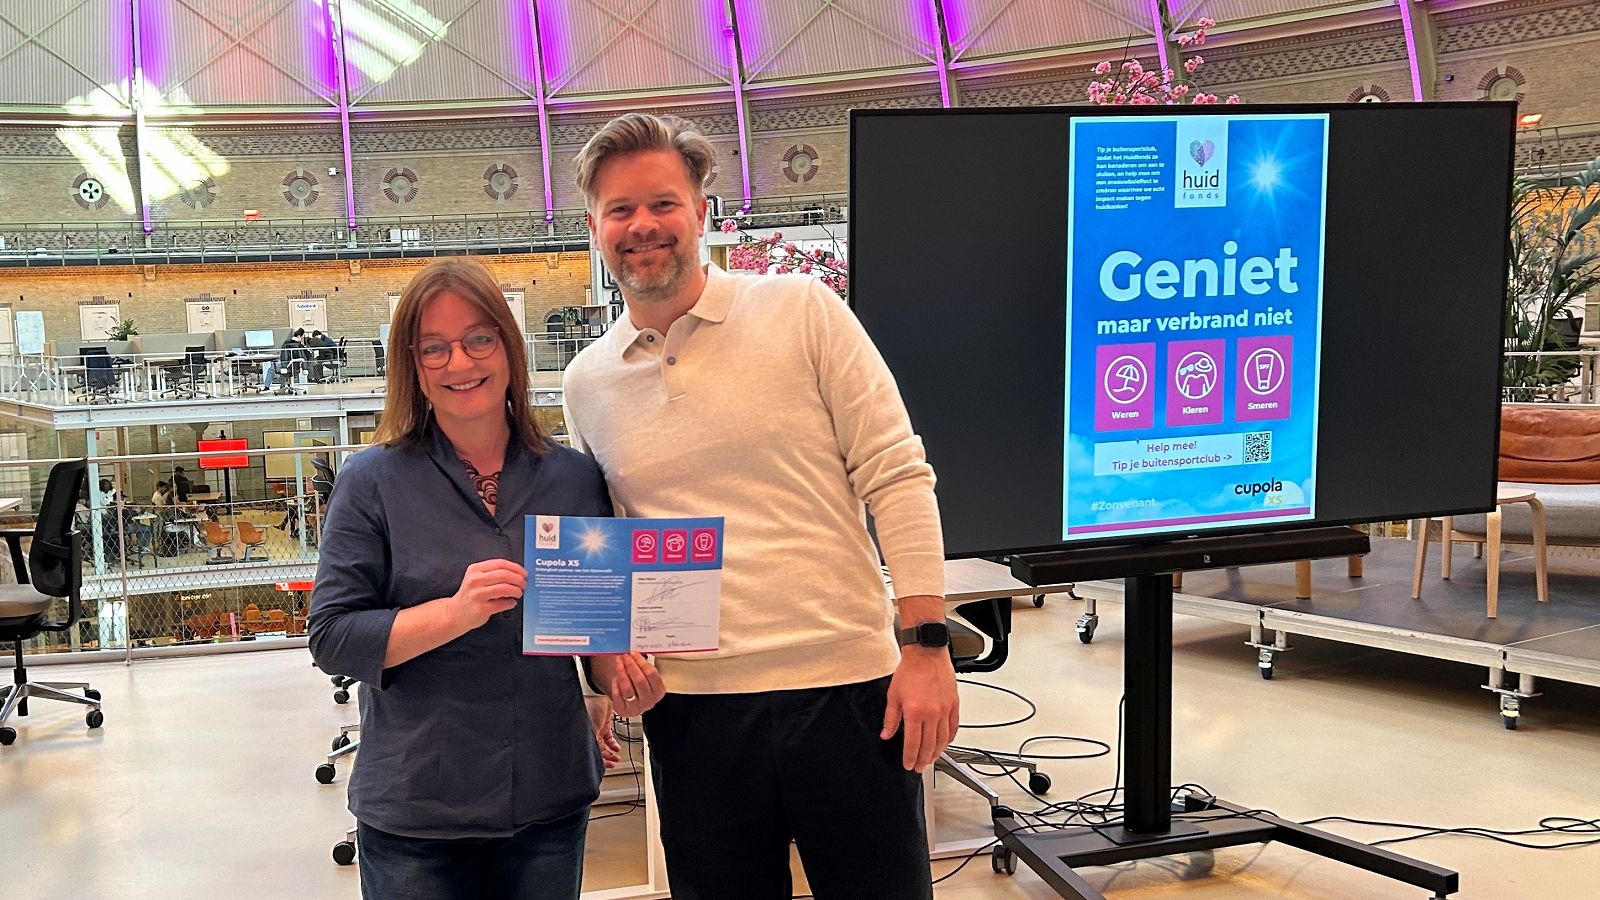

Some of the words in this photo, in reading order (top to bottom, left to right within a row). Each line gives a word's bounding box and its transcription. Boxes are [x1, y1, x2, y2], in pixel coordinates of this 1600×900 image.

[1183, 169, 1219, 188] huid
[1099, 240, 1299, 302] Geniet
[1097, 317, 1152, 335] maar
[1155, 309, 1249, 332] verbrand
[1254, 306, 1293, 326] niet
[1259, 363, 1271, 371] SPF
[1182, 405, 1209, 415] Kleren
[1248, 401, 1278, 410] Smeren
[1112, 410, 1139, 419] Weren
[1146, 443, 1170, 453] Help
[1172, 441, 1198, 451] mee!
[1112, 460, 1128, 471] Tip
[1129, 459, 1140, 471] je
[1142, 454, 1221, 468] buitensportclub
[1234, 477, 1283, 497] cupola
[1091, 498, 1156, 512] #Zonvenant
[1267, 495, 1282, 505] XS
[539, 534, 556, 542] huid
[535, 558, 566, 567] Cupola
[567, 559, 580, 567] XS
